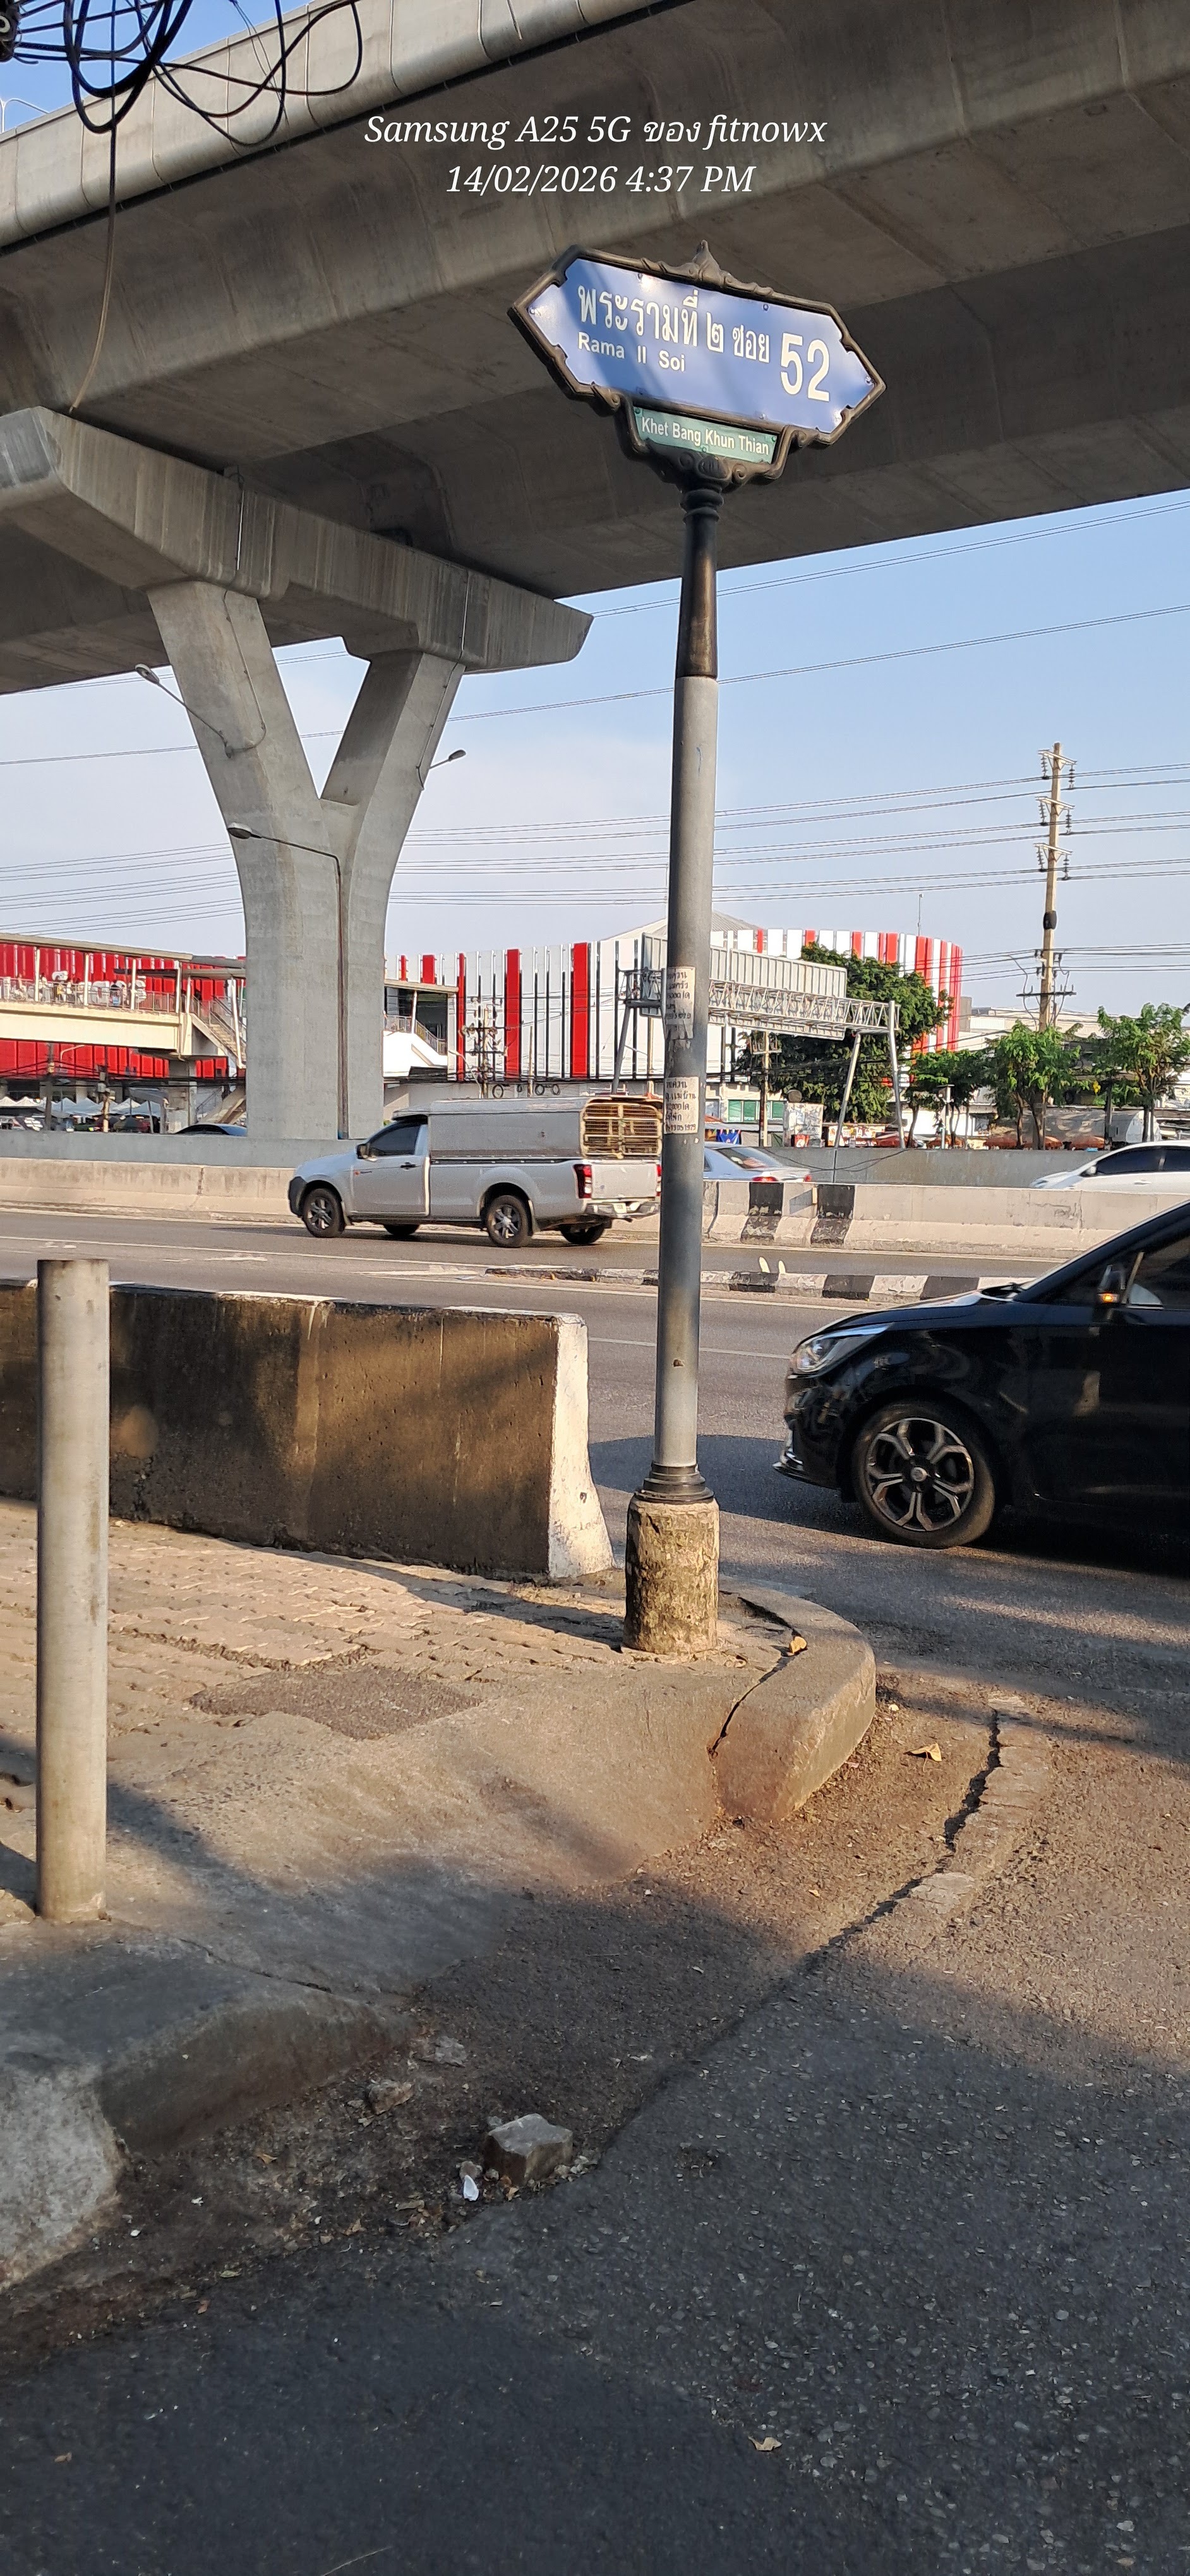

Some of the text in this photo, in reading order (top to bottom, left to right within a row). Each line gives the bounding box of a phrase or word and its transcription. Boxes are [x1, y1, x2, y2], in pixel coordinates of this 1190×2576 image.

[577, 285, 830, 402] พระรามที่ ๒ ซอย 52
[578, 331, 625, 359] Rama
[659, 350, 685, 372] Soi
[642, 417, 769, 455] Khet Bang Khun Thian
